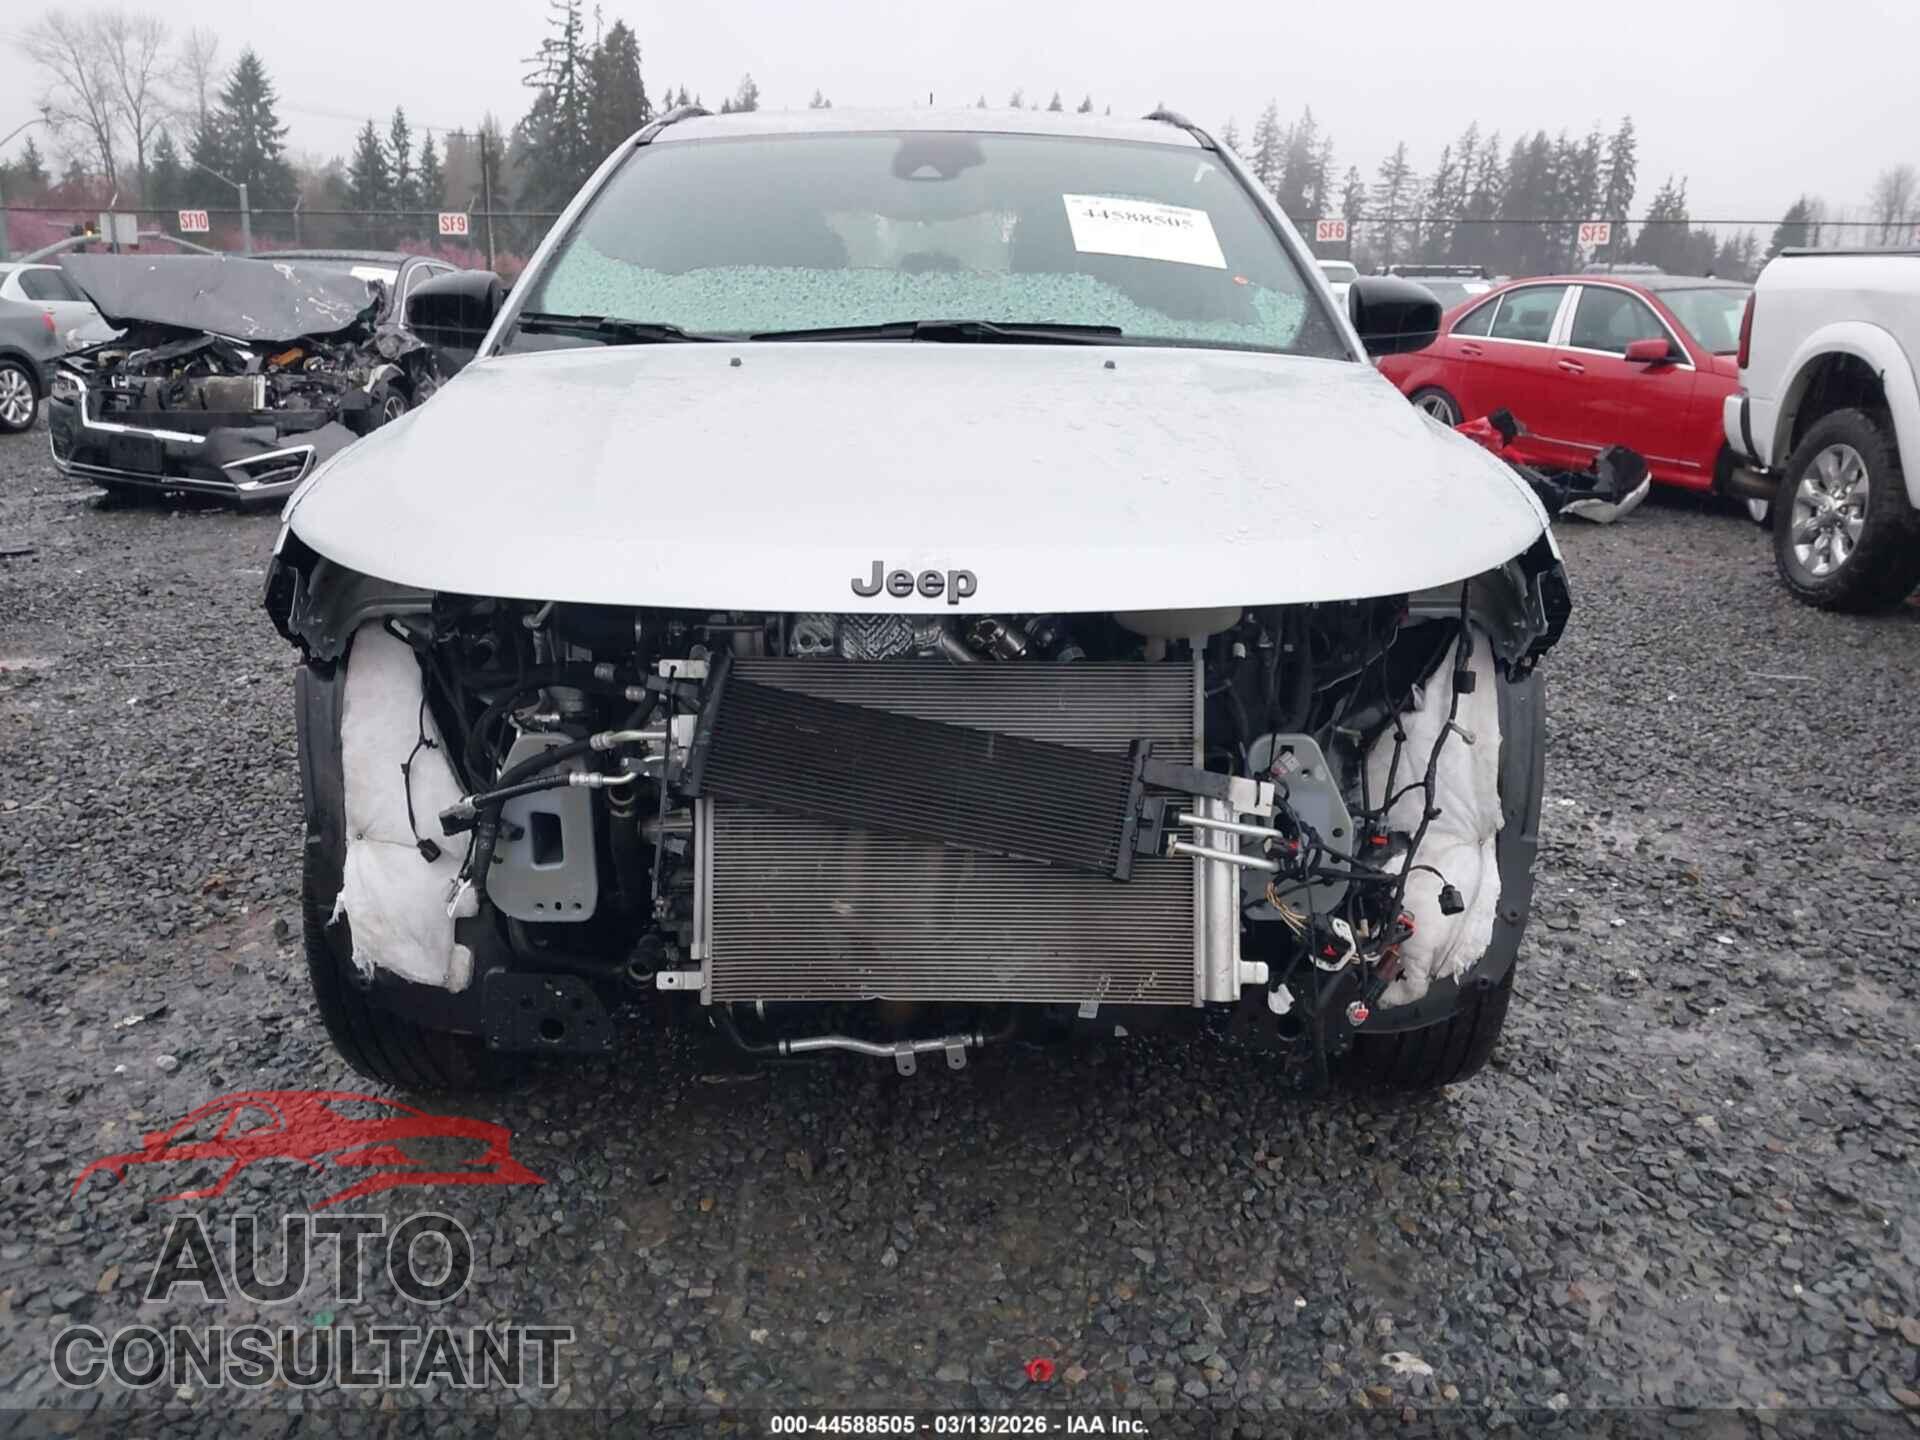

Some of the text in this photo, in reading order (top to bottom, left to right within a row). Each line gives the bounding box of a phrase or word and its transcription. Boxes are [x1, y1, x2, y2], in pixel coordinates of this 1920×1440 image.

[180, 212, 208, 229] SF10
[441, 215, 465, 232] SF9
[1319, 222, 1345, 239] SF6
[1581, 225, 1608, 241] SF5
[851, 560, 978, 605] Jeep
